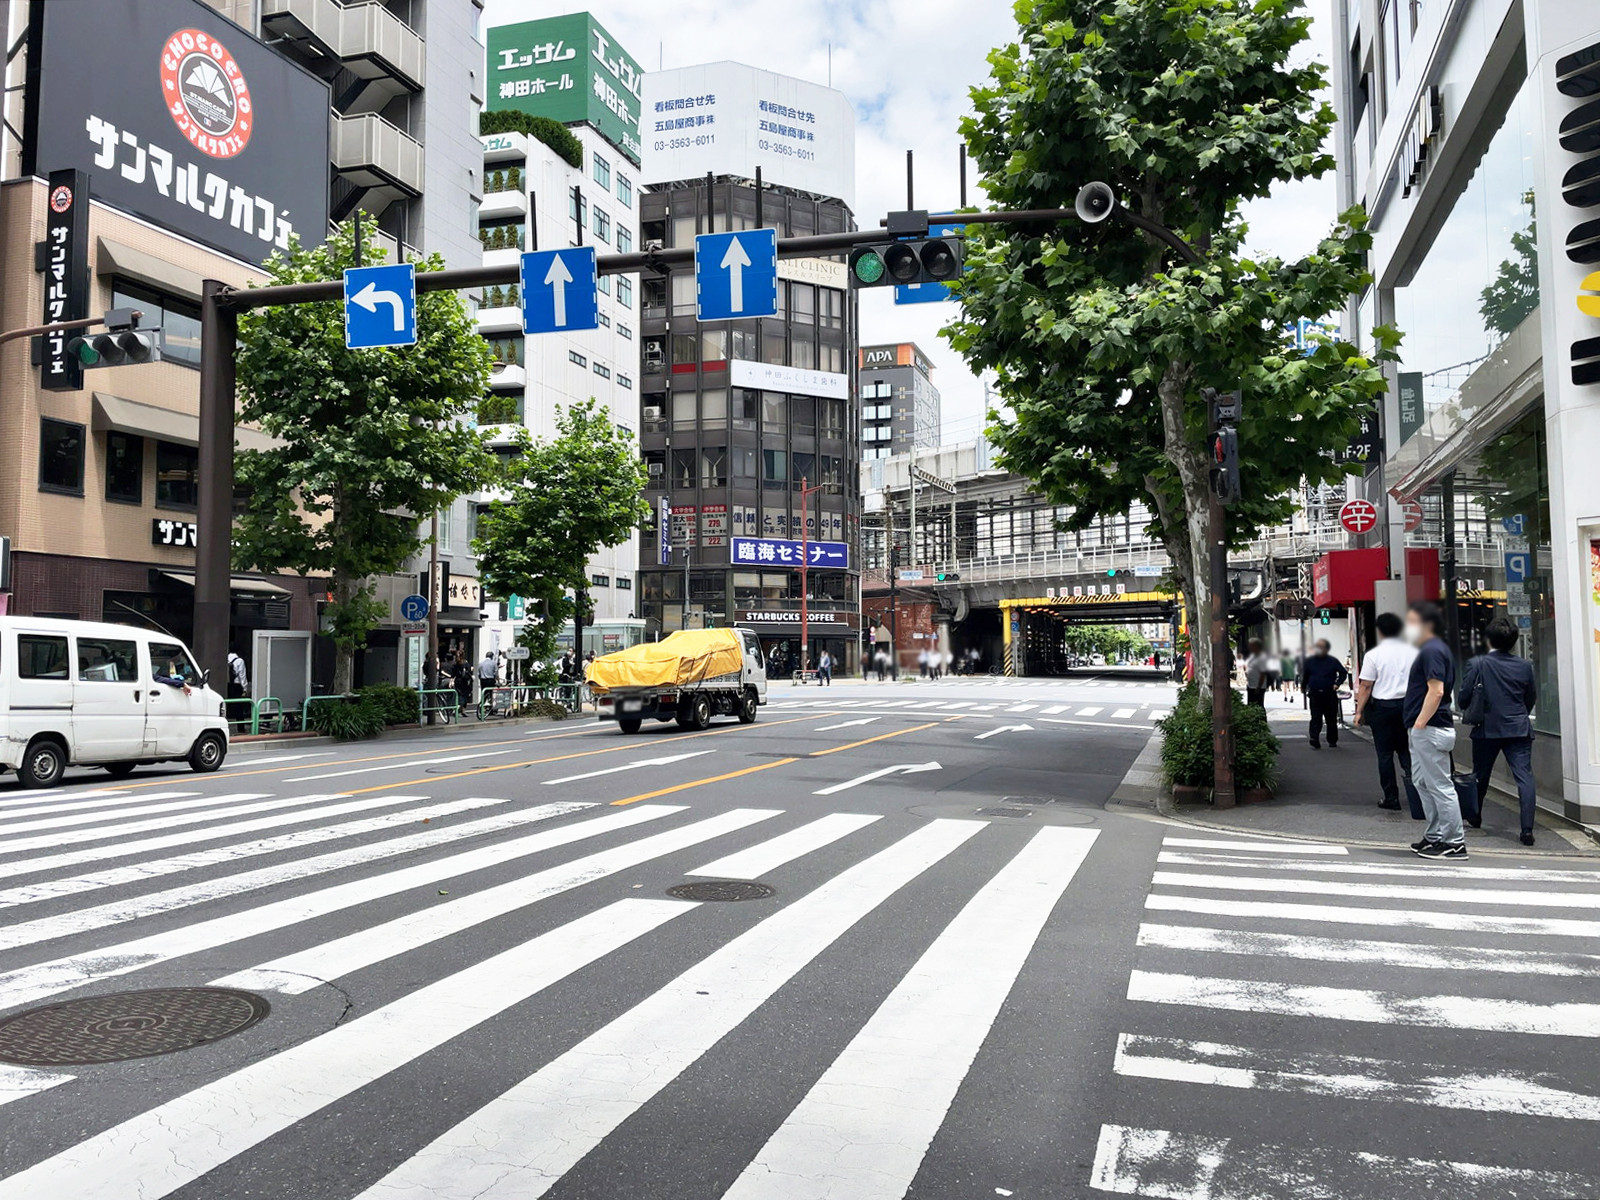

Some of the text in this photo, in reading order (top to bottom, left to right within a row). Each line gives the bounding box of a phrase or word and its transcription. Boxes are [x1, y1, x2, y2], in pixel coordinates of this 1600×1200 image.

[497, 41, 576, 70] エッサム
[164, 33, 223, 71] CHOCO
[226, 60, 250, 113] CRO
[499, 73, 574, 99] 神田ホール
[654, 94, 716, 113] 看板問合せ先
[759, 100, 815, 124] 看板問合せ先
[654, 134, 716, 151] 03-3563-6011
[758, 139, 815, 161] 03-3563-6011
[800, 260, 841, 276] CLINIC
[867, 350, 893, 363] APA
[1342, 502, 1375, 532] 辛
[738, 542, 843, 563] 臨海セミナー
[746, 612, 800, 621] STARBUCKS
